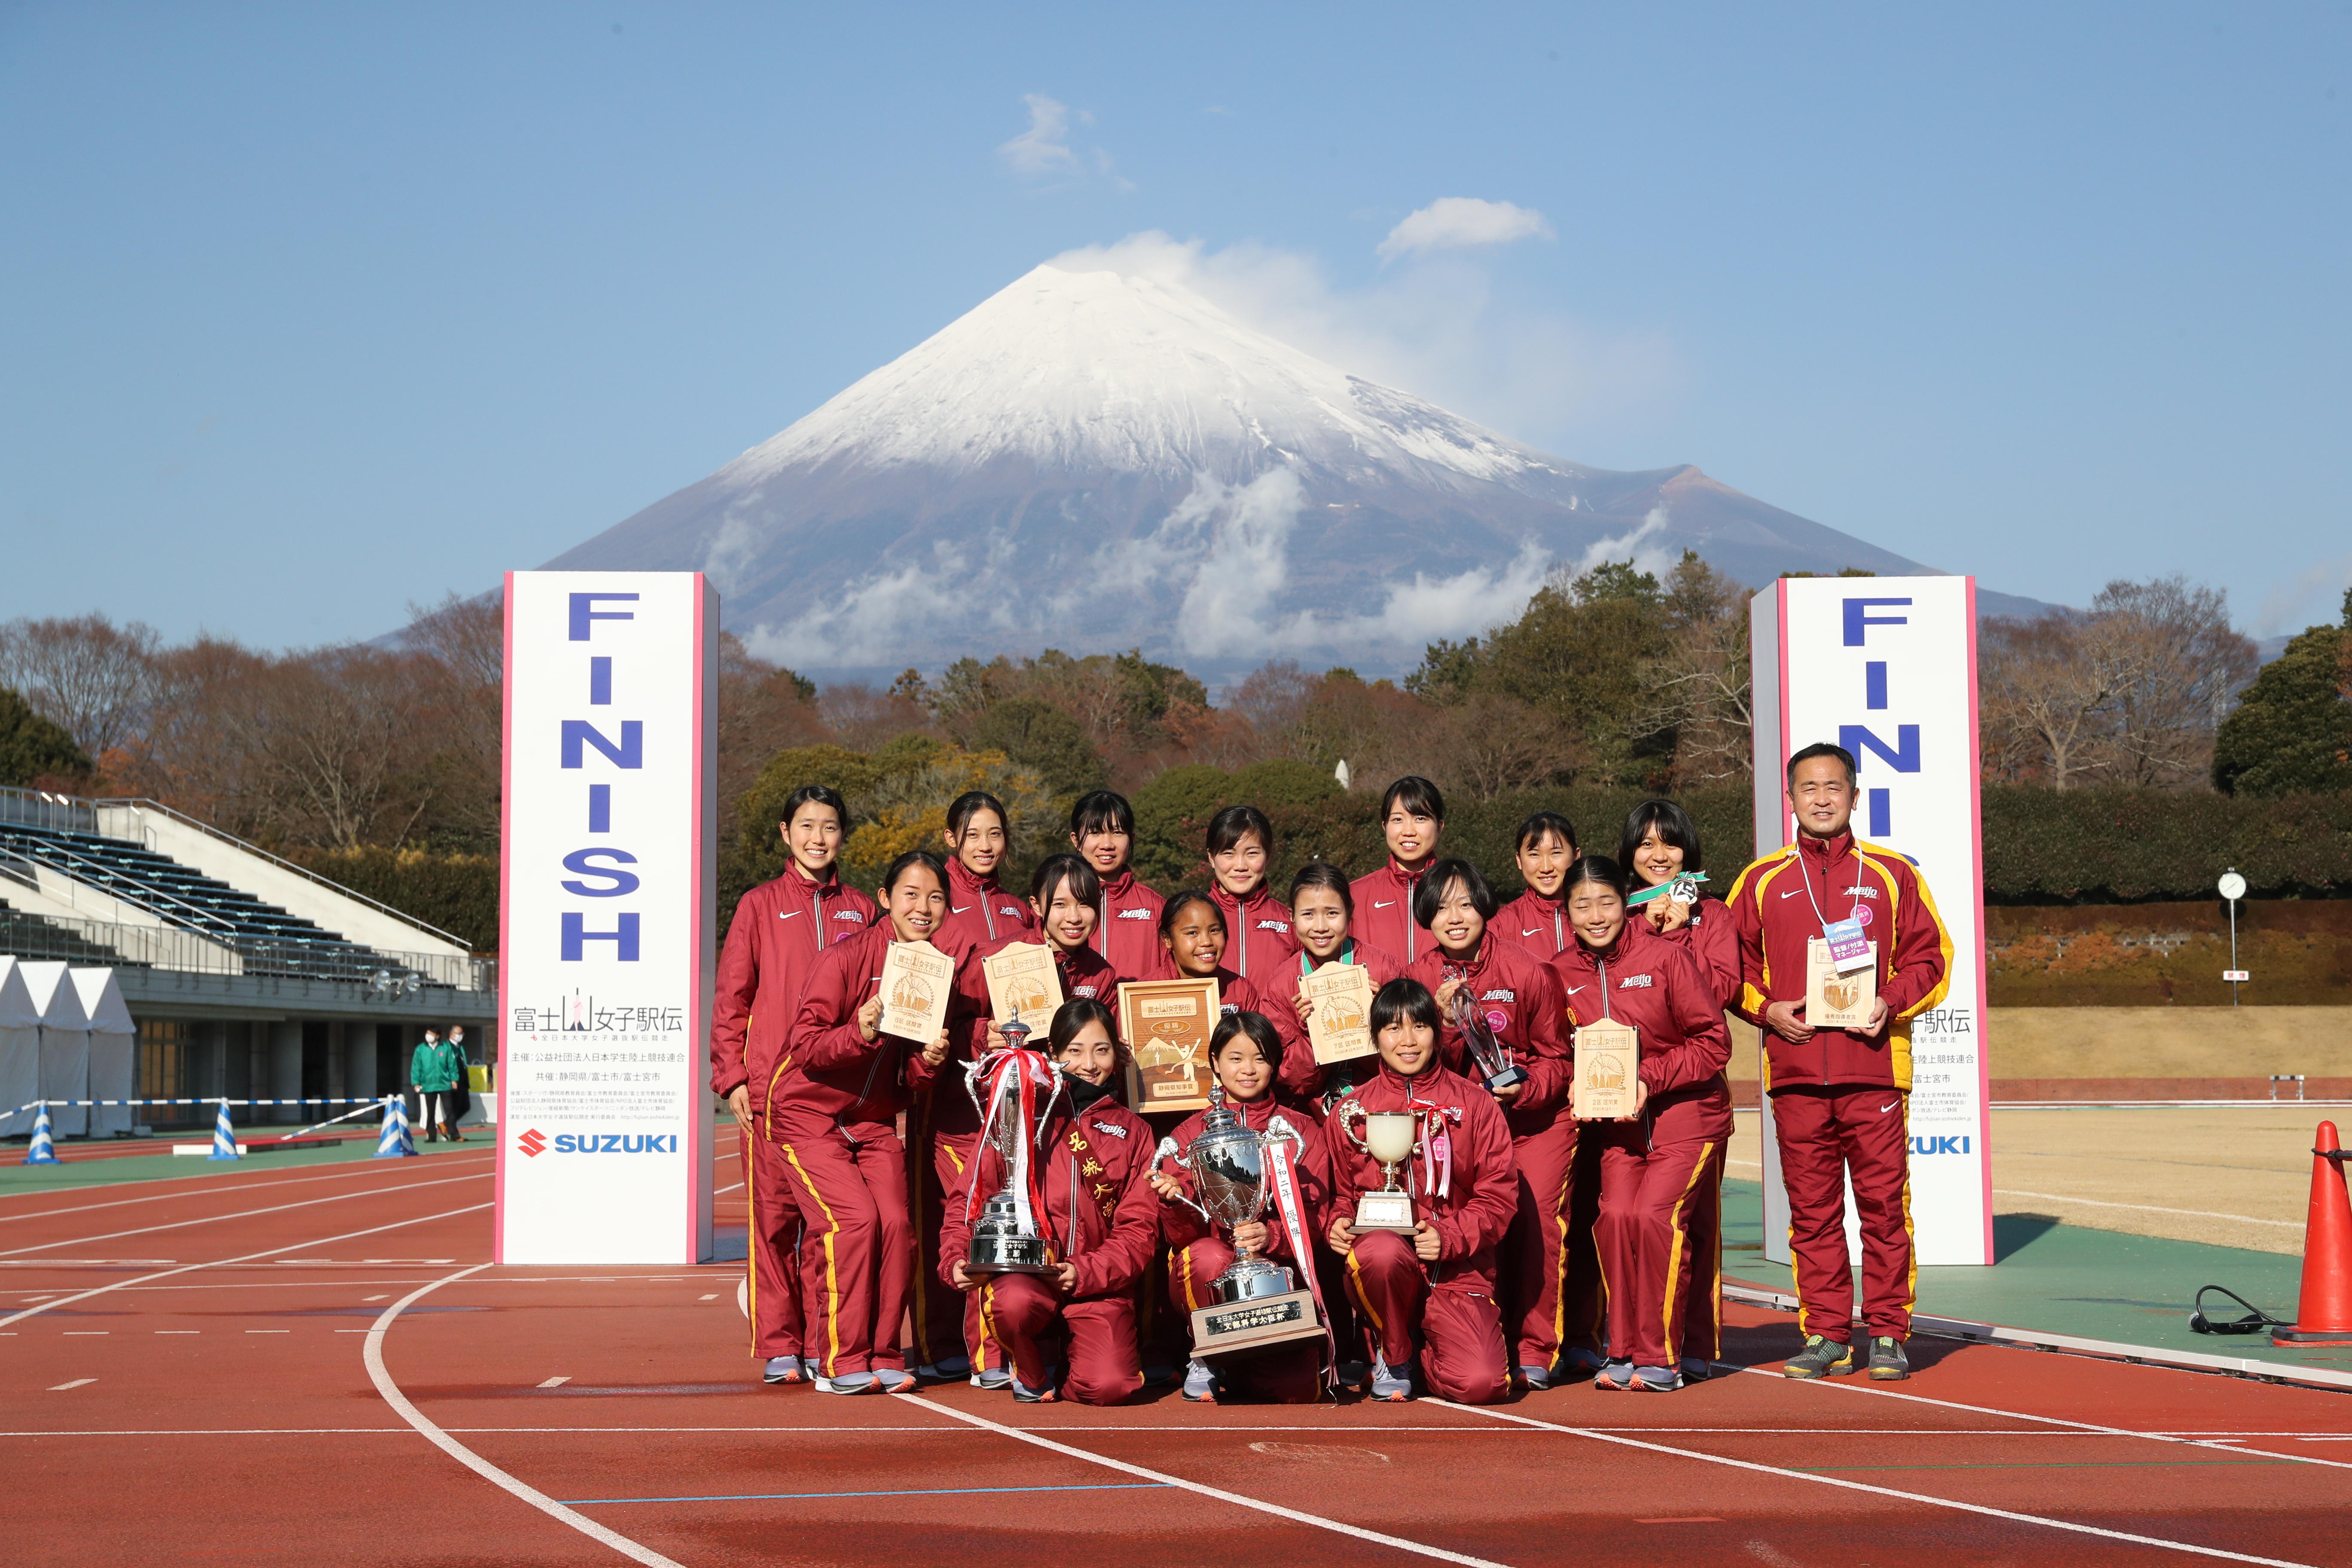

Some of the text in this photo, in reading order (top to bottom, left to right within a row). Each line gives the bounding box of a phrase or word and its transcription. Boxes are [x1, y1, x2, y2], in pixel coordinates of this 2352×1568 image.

[560, 593, 643, 962] FINISH
[1843, 886, 1877, 898] Meijo
[833, 910, 862, 922] Meijo
[1117, 908, 1151, 920] Meijo
[1256, 920, 1288, 932] Meijo
[1833, 940, 1865, 953] 監督/付添
[1835, 948, 1865, 959] マネージャー
[1619, 973, 1651, 988] Meijo
[1071, 985, 1097, 998] Meijo
[1480, 989, 1514, 1002] Meijo
[514, 987, 683, 1032] 富士山女子駅伝
[1148, 1001, 1191, 1014] 富士山女子駅伝
[1093, 1120, 1127, 1136] Meijo
[554, 1134, 677, 1153] SUZUKI
[1275, 1155, 1291, 1200] 令和二年
[1286, 1210, 1301, 1238] 優勝
[1216, 1305, 1289, 1323] 全日本大学女子選抜駅伝競走
[1223, 1312, 1285, 1331] 文部科学大臣杯
